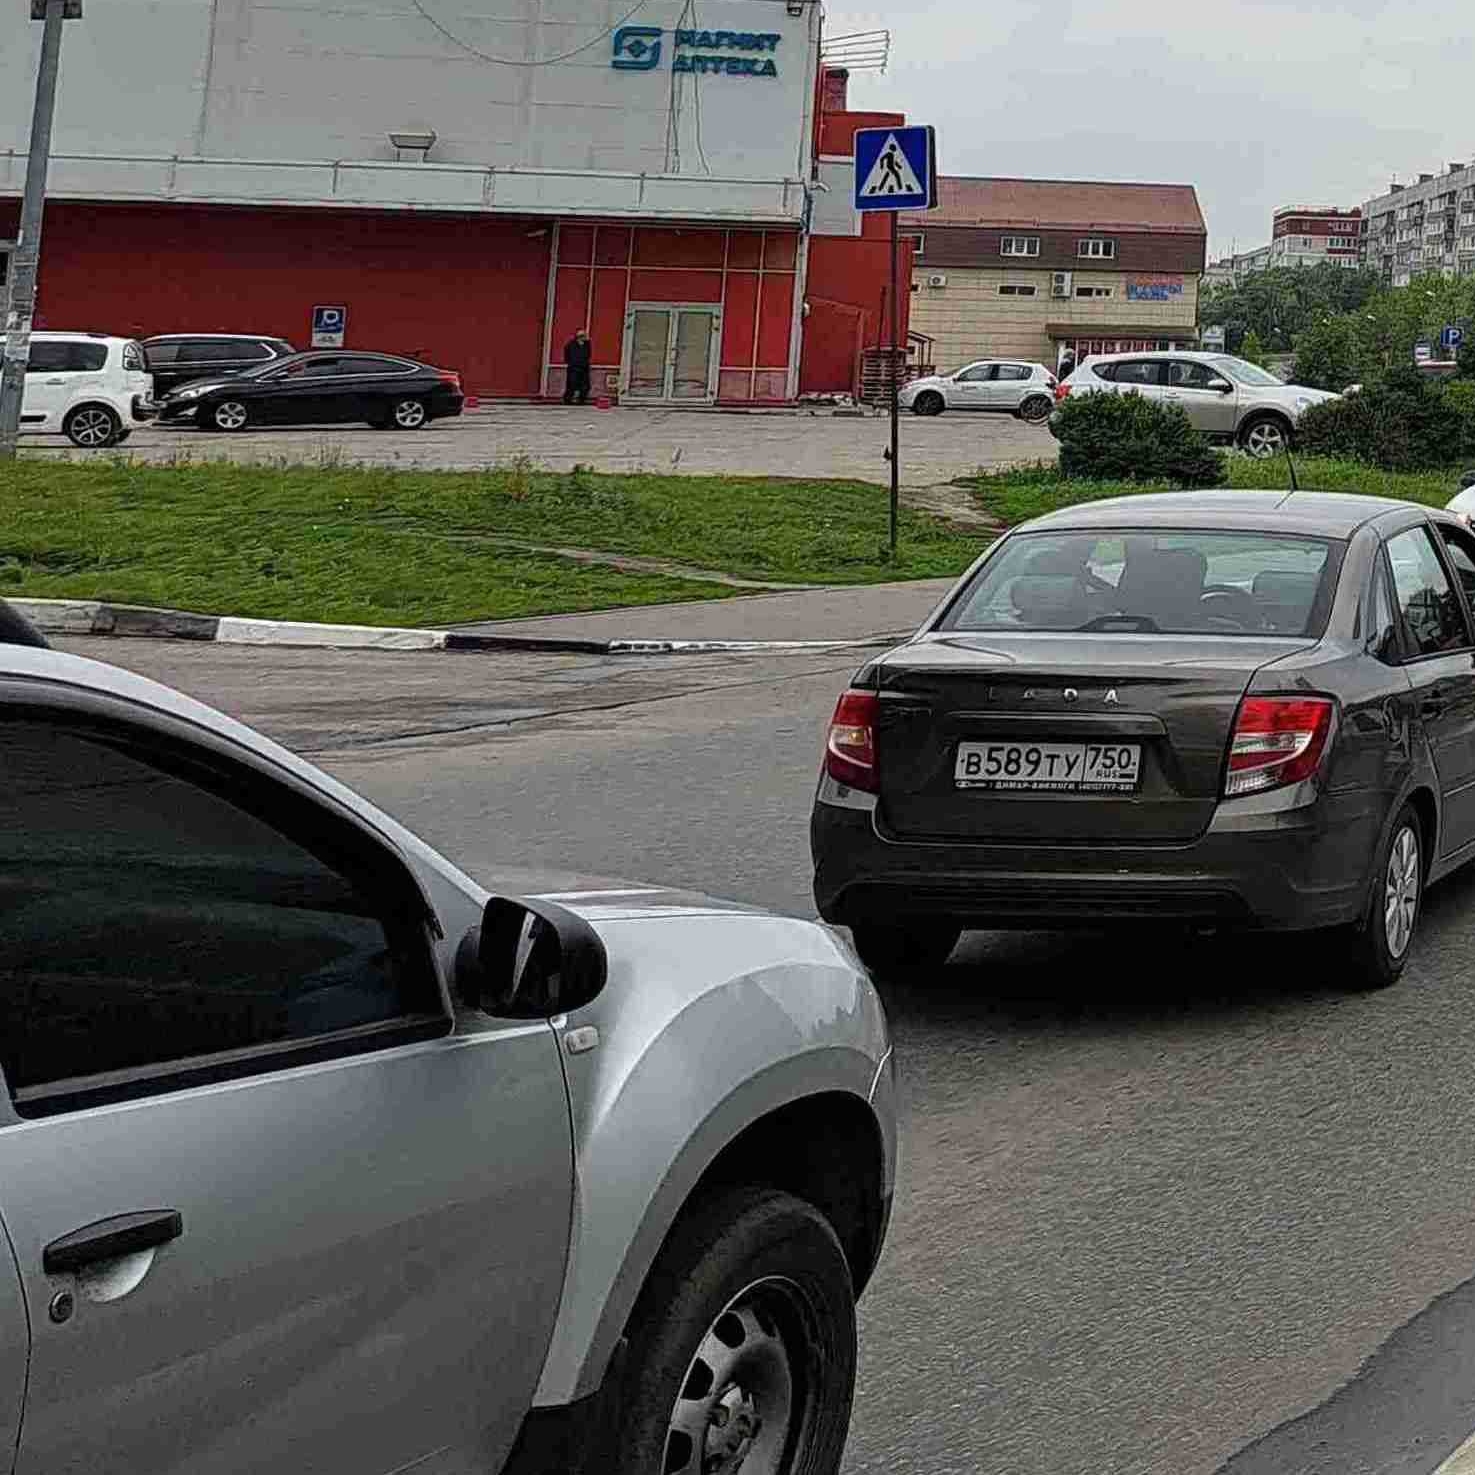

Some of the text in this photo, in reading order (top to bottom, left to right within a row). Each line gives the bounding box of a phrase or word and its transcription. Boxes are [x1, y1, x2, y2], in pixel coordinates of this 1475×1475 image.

[673, 55, 778, 77] АПТЕКА
[965, 746, 1132, 777] В589ТУ 750
